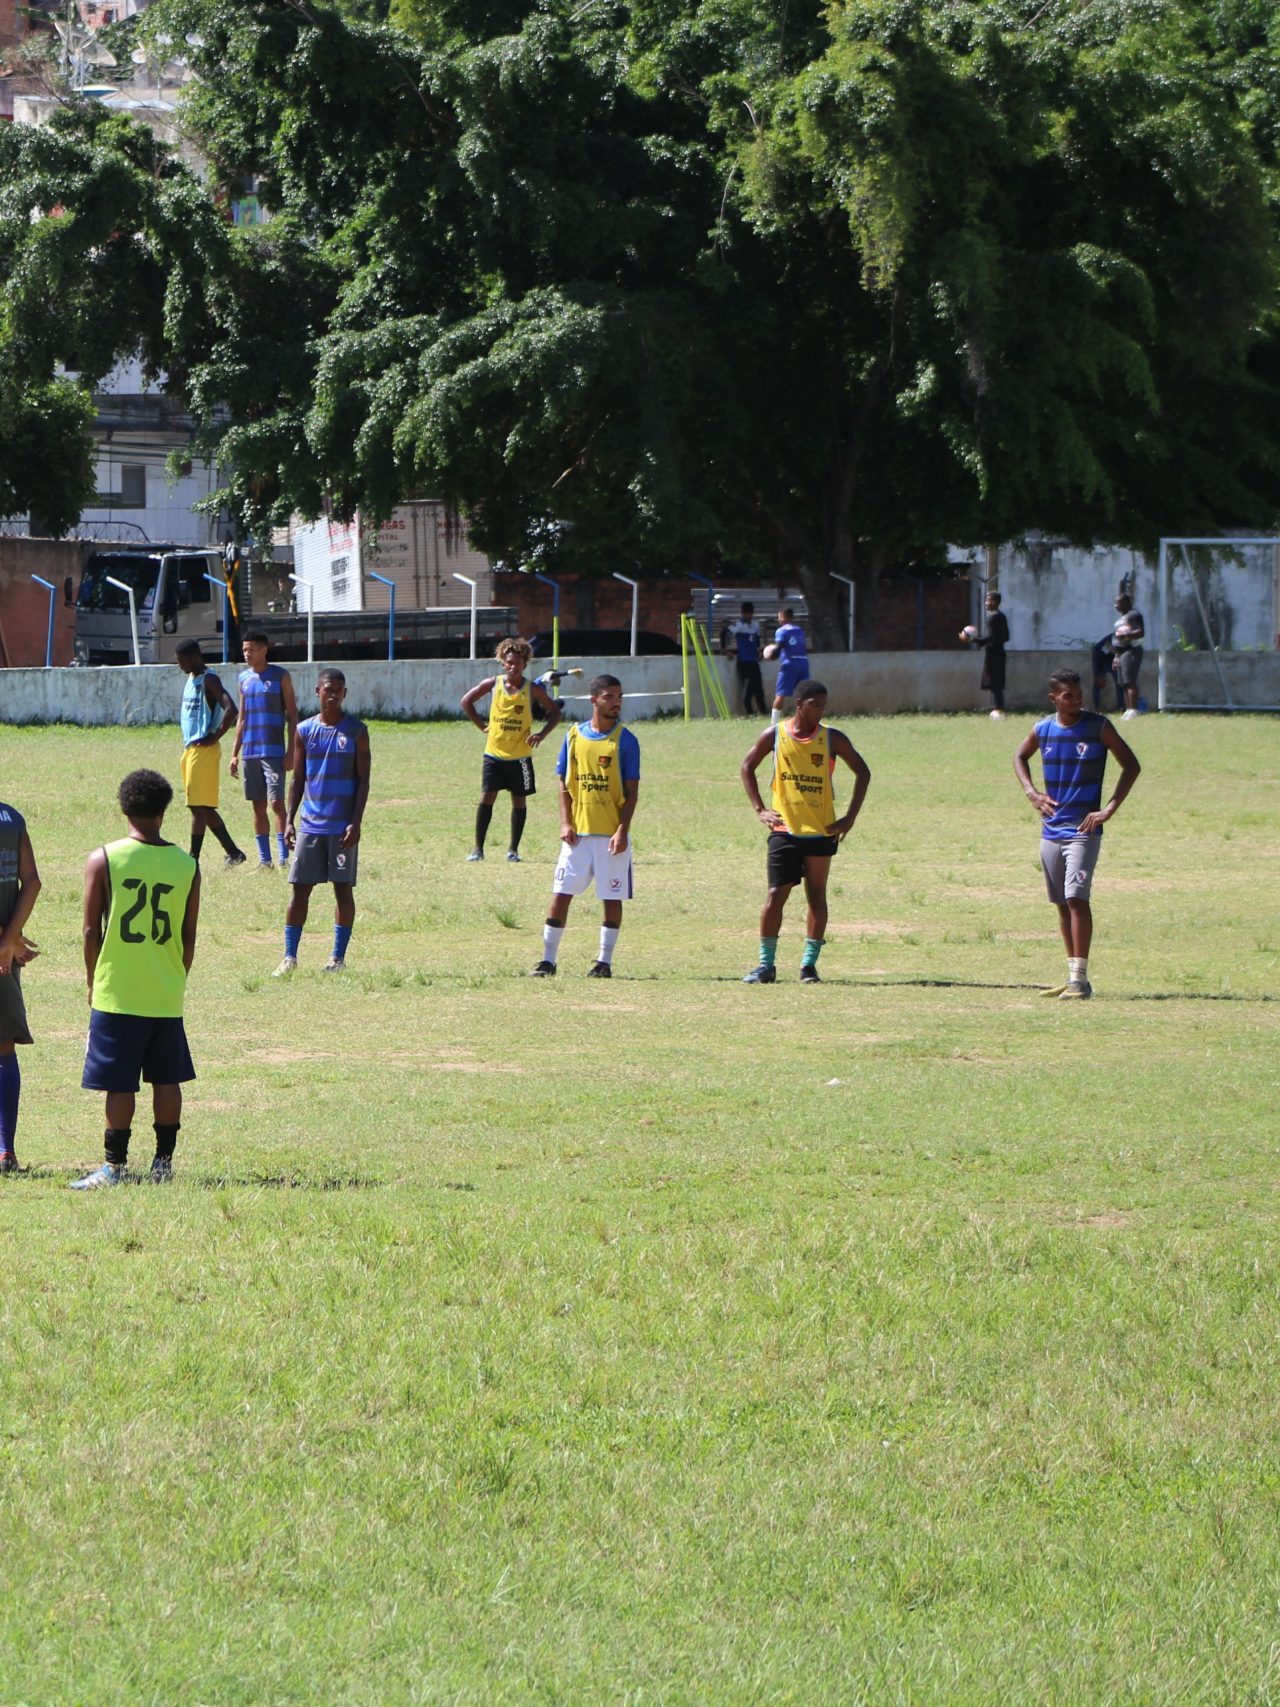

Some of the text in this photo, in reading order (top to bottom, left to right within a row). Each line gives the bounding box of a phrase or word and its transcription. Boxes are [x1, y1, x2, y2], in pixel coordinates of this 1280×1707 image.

[781, 771, 823, 785] Santana
[581, 781, 609, 793] Sport
[794, 782, 823, 795] Sport
[120, 878, 174, 945] 26
